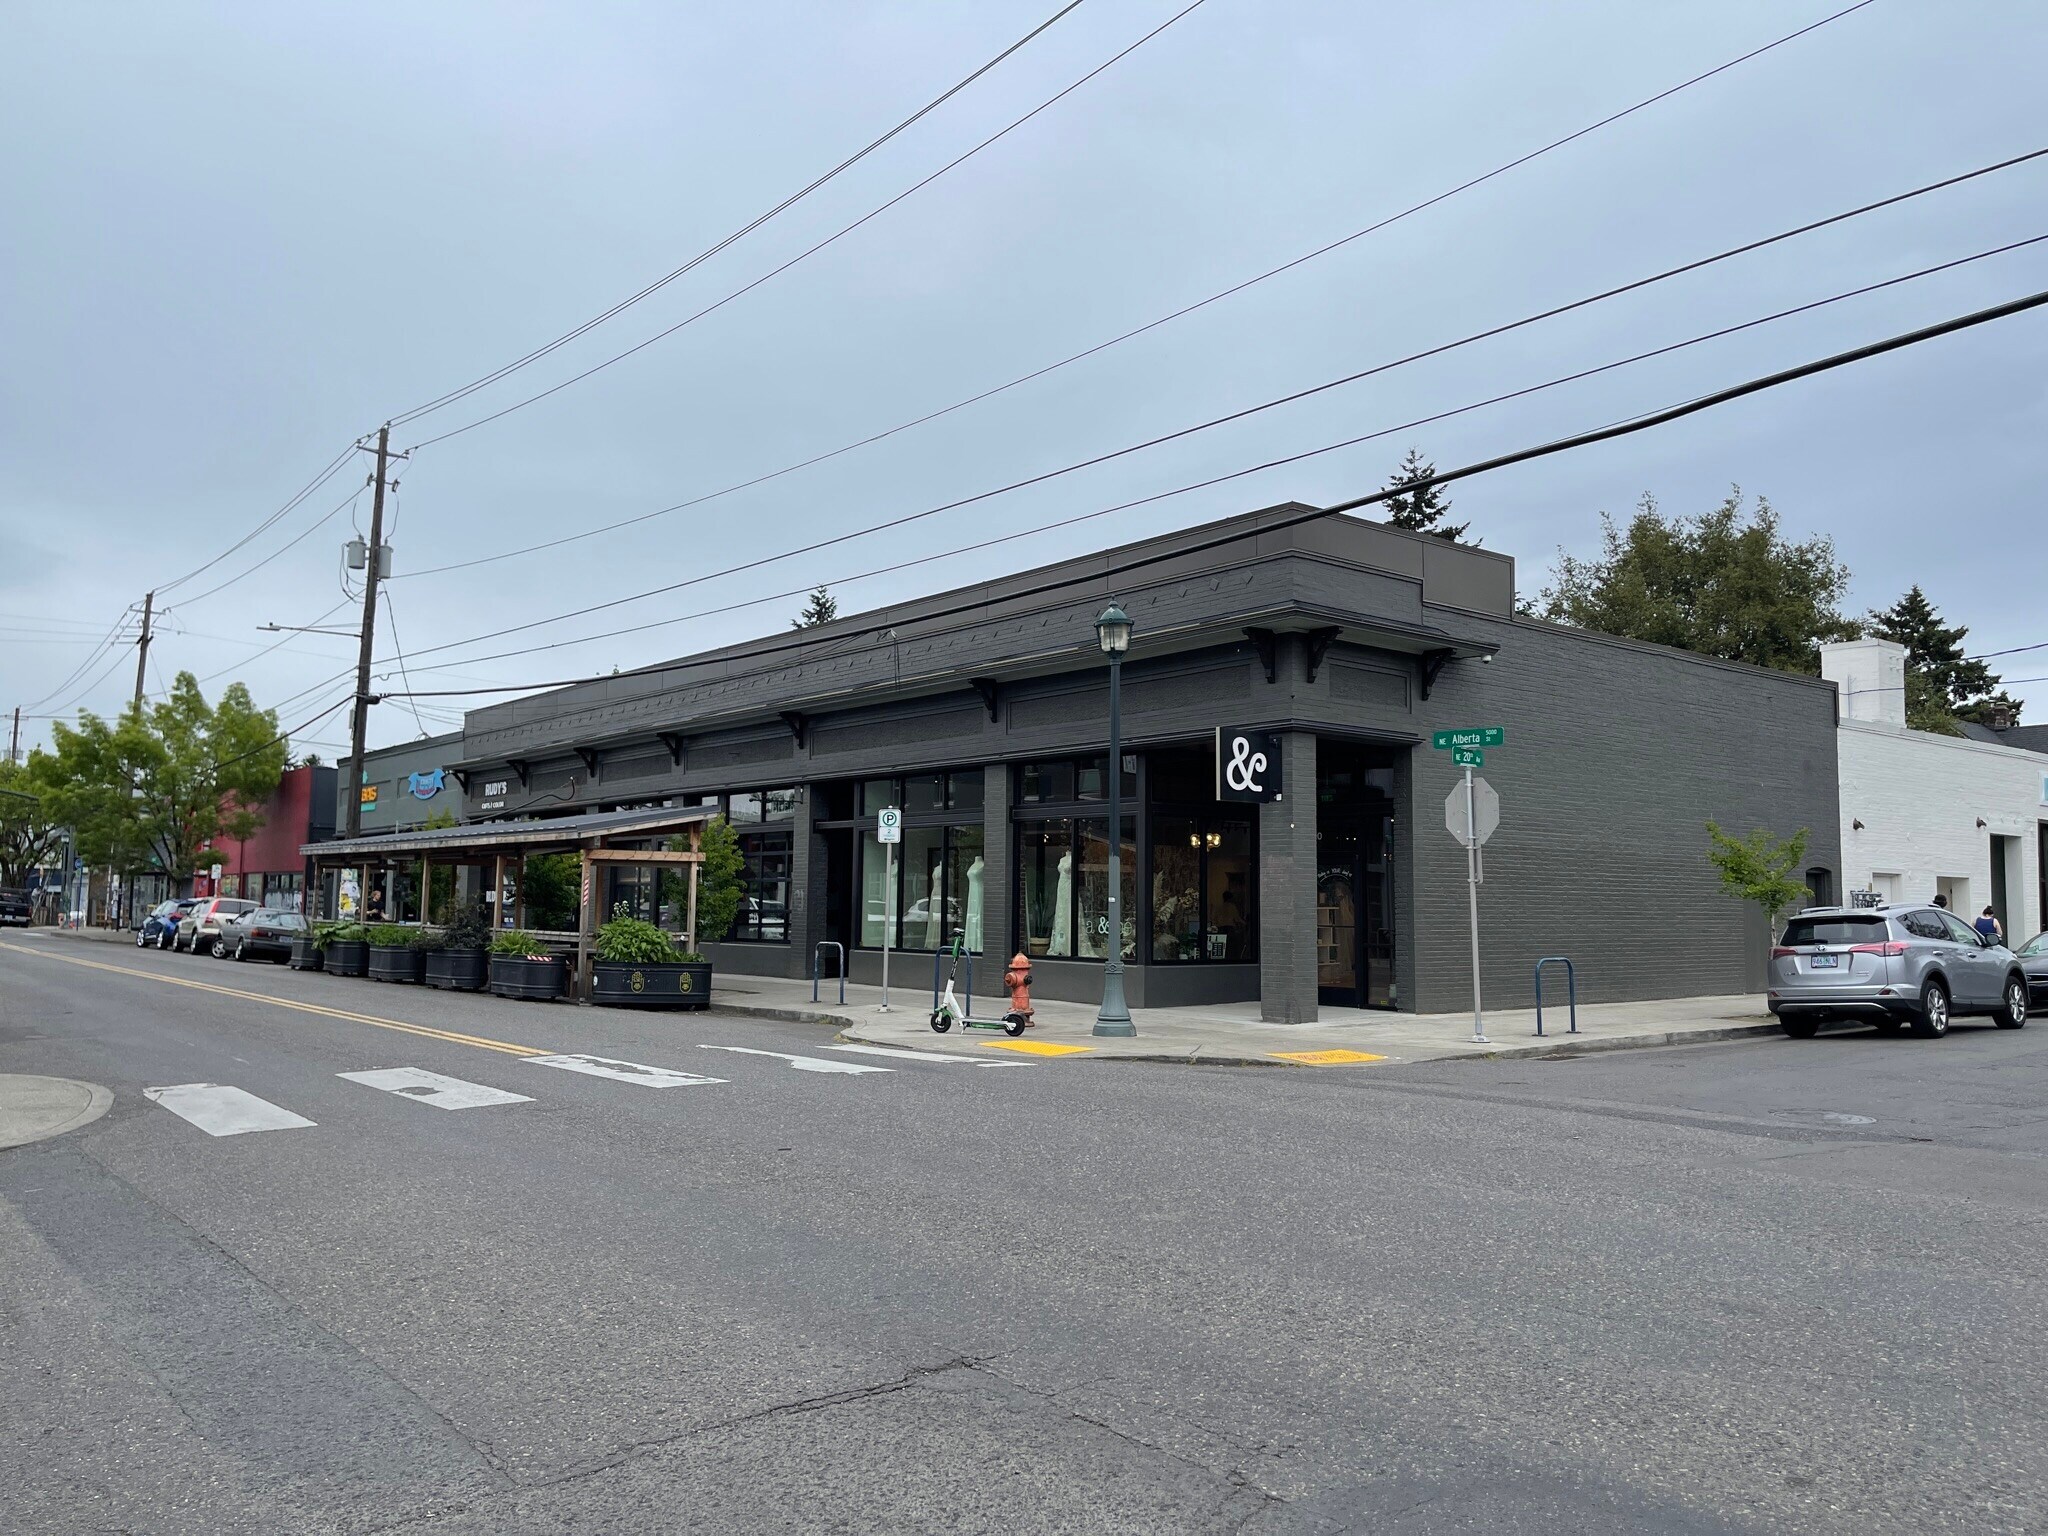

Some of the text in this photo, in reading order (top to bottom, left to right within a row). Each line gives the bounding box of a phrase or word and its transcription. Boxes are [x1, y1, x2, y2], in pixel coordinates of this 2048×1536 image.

[1452, 733, 1480, 744] Alberta
[1226, 736, 1267, 792] &
[485, 781, 507, 796] RUDY'S
[886, 814, 894, 823] P
